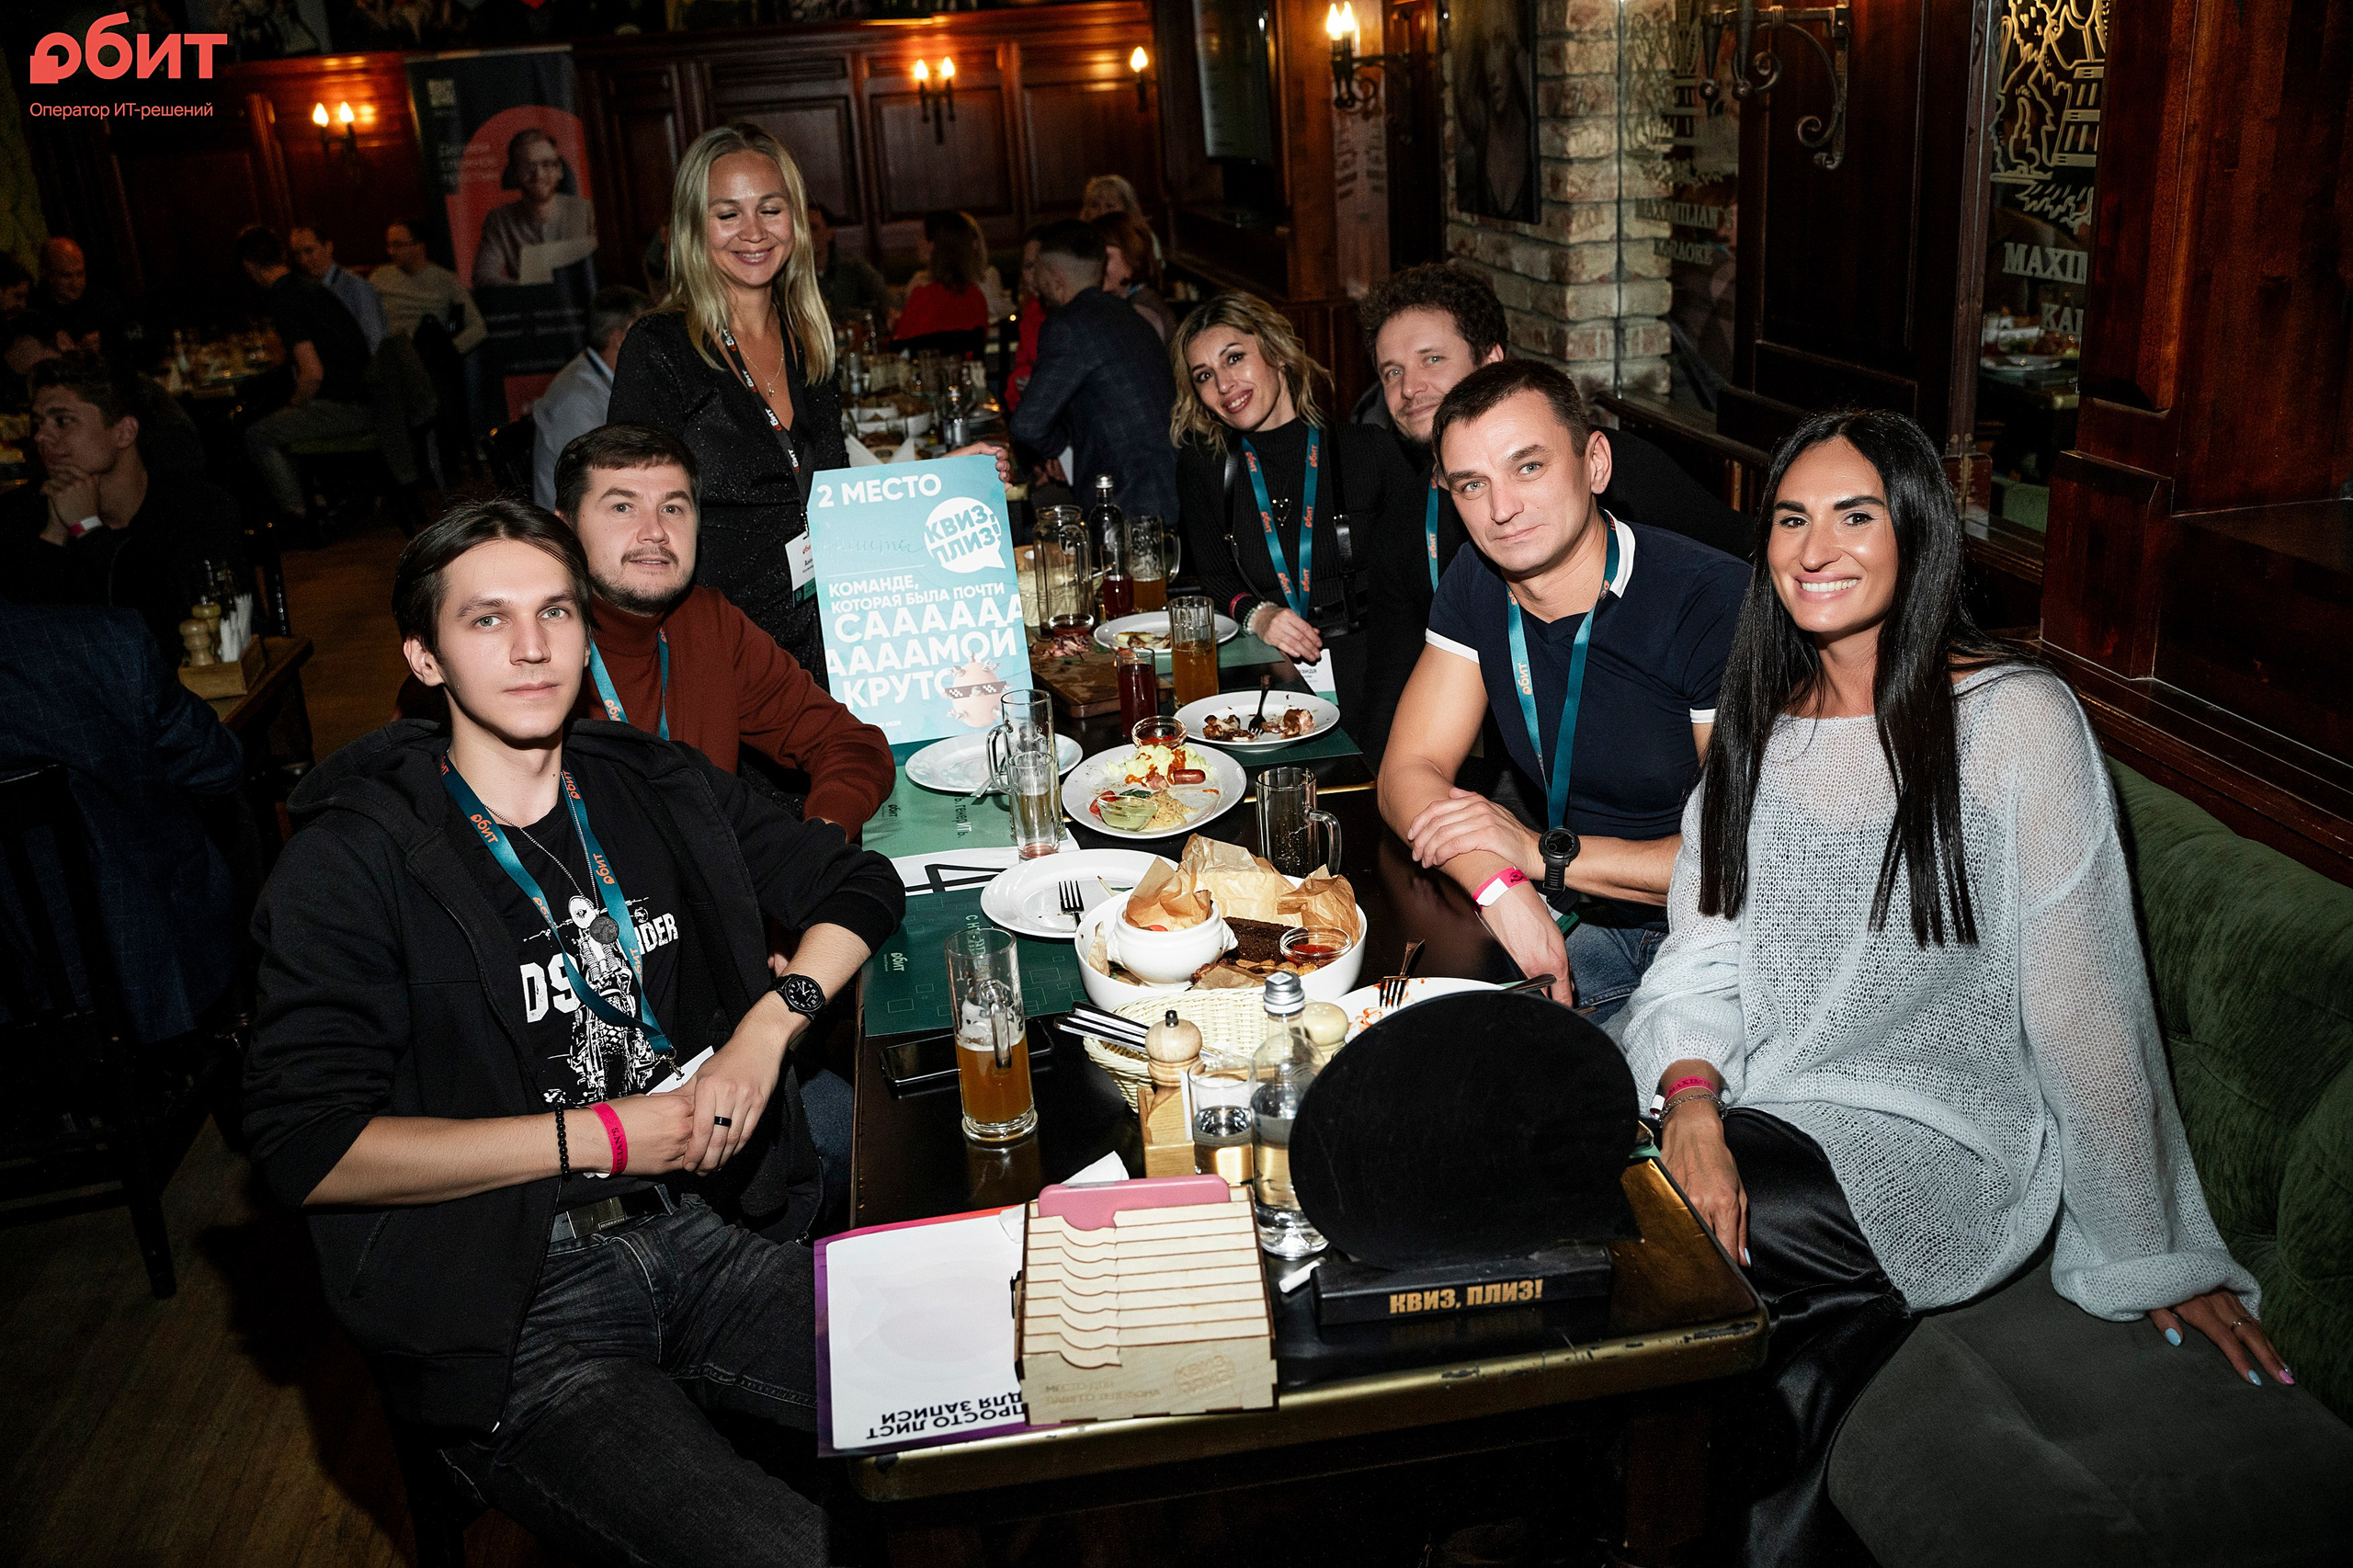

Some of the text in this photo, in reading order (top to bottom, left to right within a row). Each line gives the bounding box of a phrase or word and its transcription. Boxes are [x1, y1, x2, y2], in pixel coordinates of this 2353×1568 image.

[816, 473, 942, 508] 2 МЕСТО
[926, 506, 996, 543] КВИЗ,
[930, 523, 1002, 563] ПЛИЗ!
[829, 574, 918, 597] КОМАНДЕ,
[831, 582, 1006, 614] КОТОРАЯ БЫЛА ПОЧТИ
[1518, 663, 1532, 696] обит
[604, 699, 621, 722] оби
[470, 813, 498, 843] обит
[593, 853, 616, 885] обит
[1389, 1278, 1544, 1314] КВИЗ, ПЛИЗ!
[866, 1403, 1024, 1439] ПРОСТО ЛИСТ
[881, 1392, 1022, 1425] ДЛЯ ЗАПИСИ
